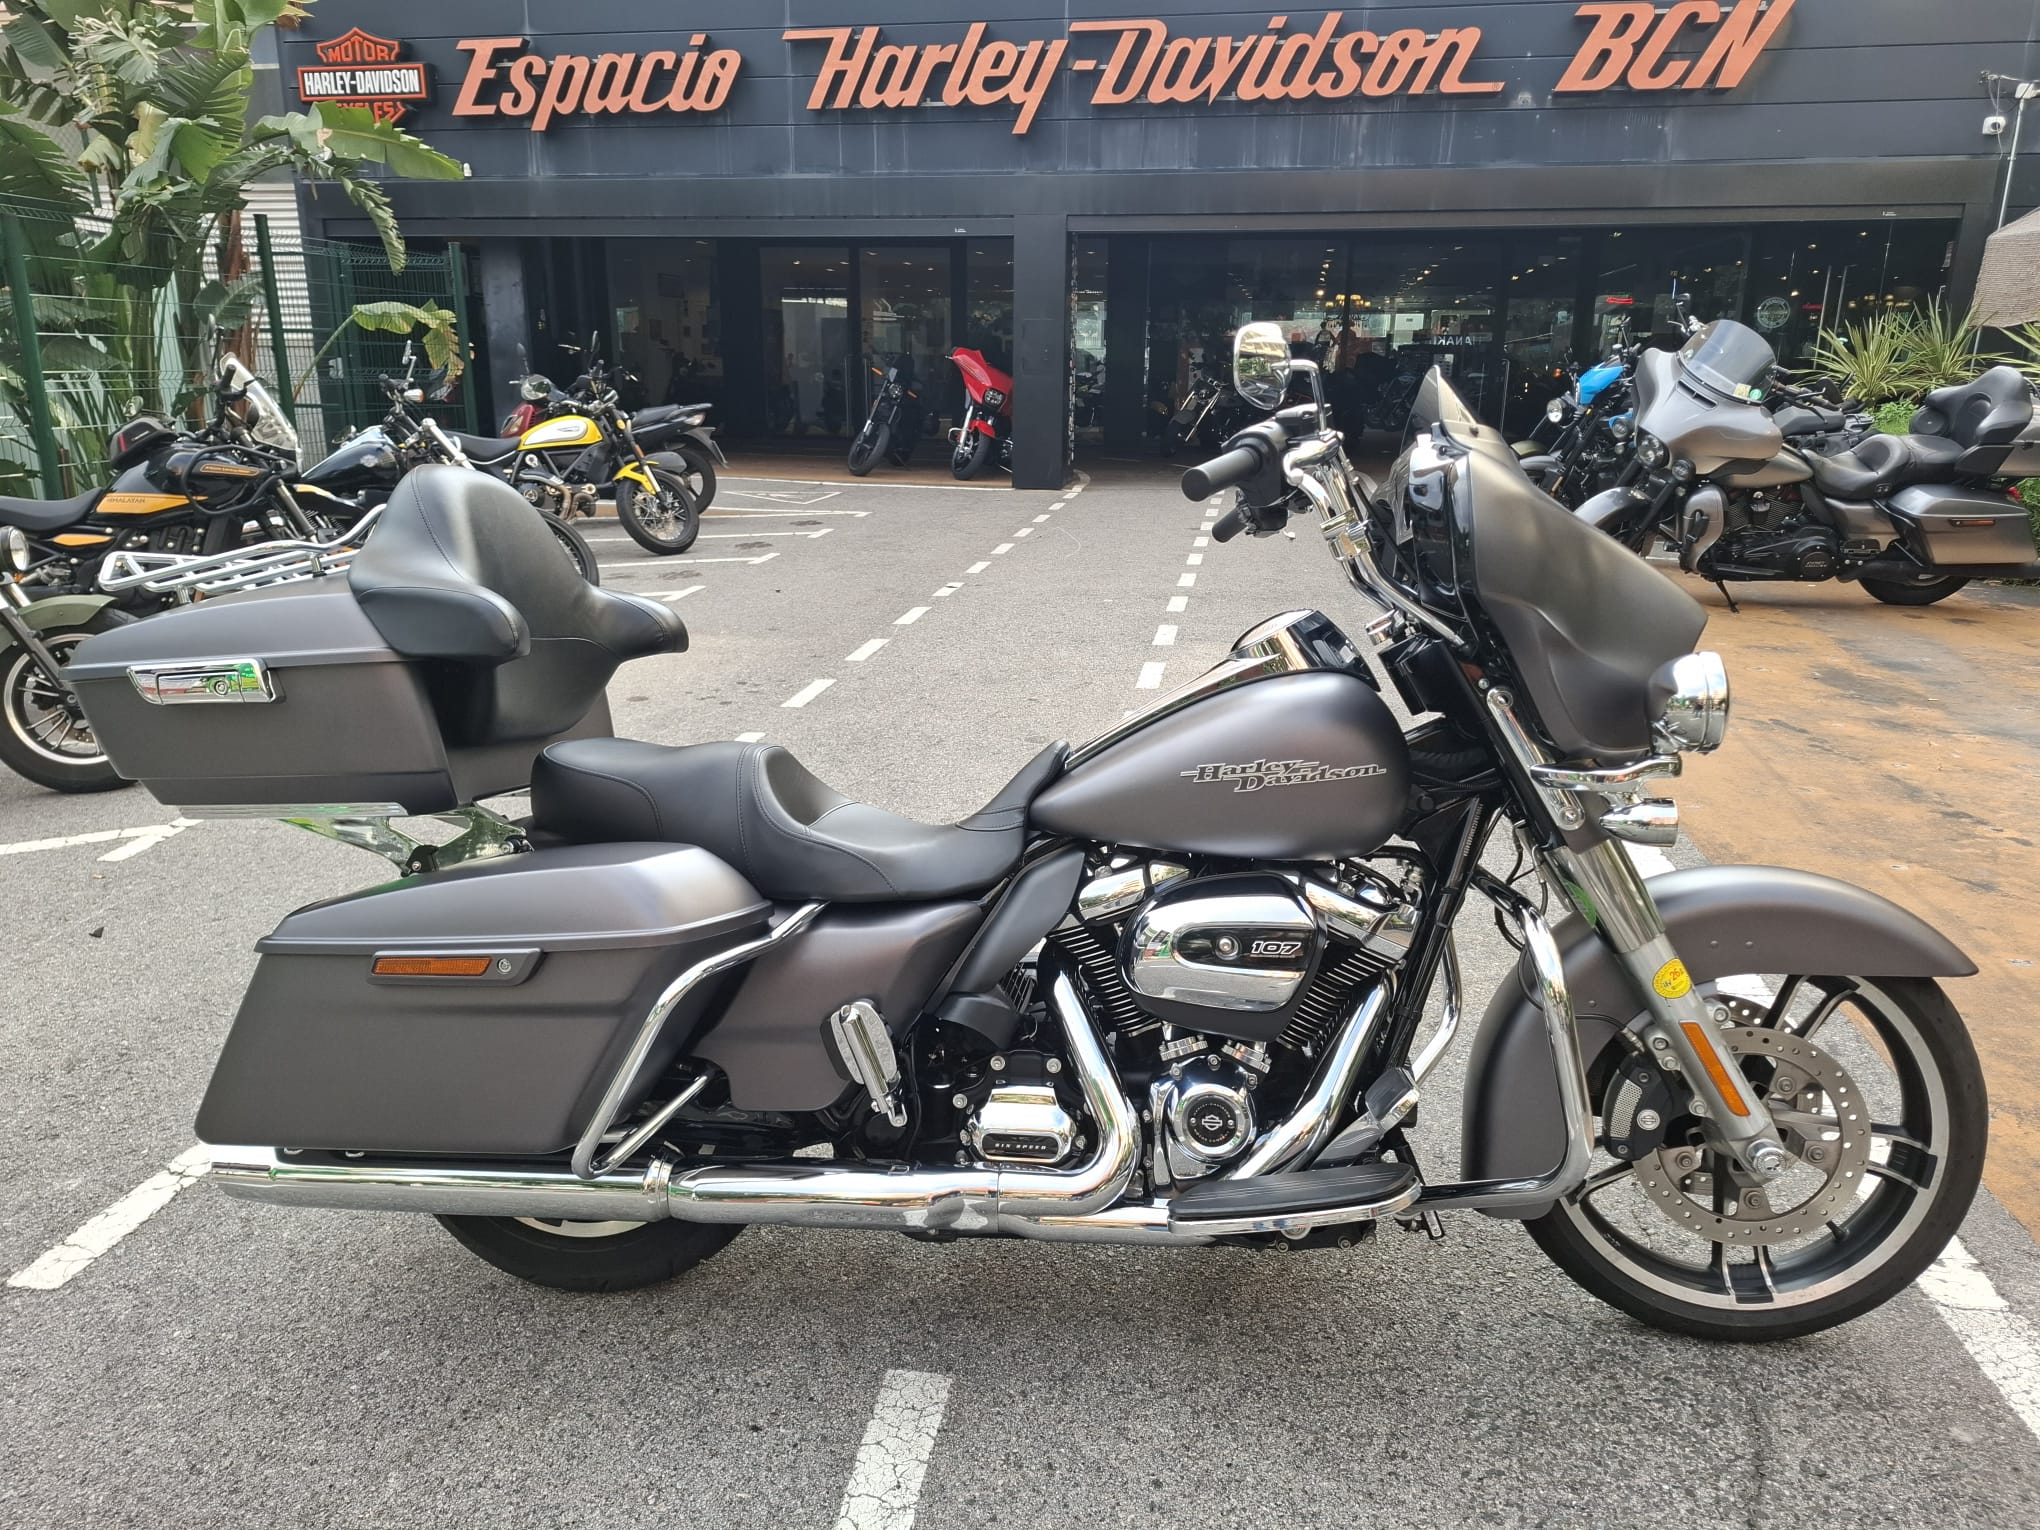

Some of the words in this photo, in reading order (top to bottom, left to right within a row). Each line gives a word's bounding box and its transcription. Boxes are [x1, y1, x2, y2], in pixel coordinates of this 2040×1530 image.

[328, 36, 390, 62] MOTOR
[451, 33, 742, 132] Espacio
[782, 11, 1507, 135] Harley-Davidson
[1554, 0, 1796, 91] BCN
[303, 69, 420, 95] HARLEY-DAVIDSON
[1224, 764, 1387, 792] Davidson
[1251, 941, 1302, 955] 107
